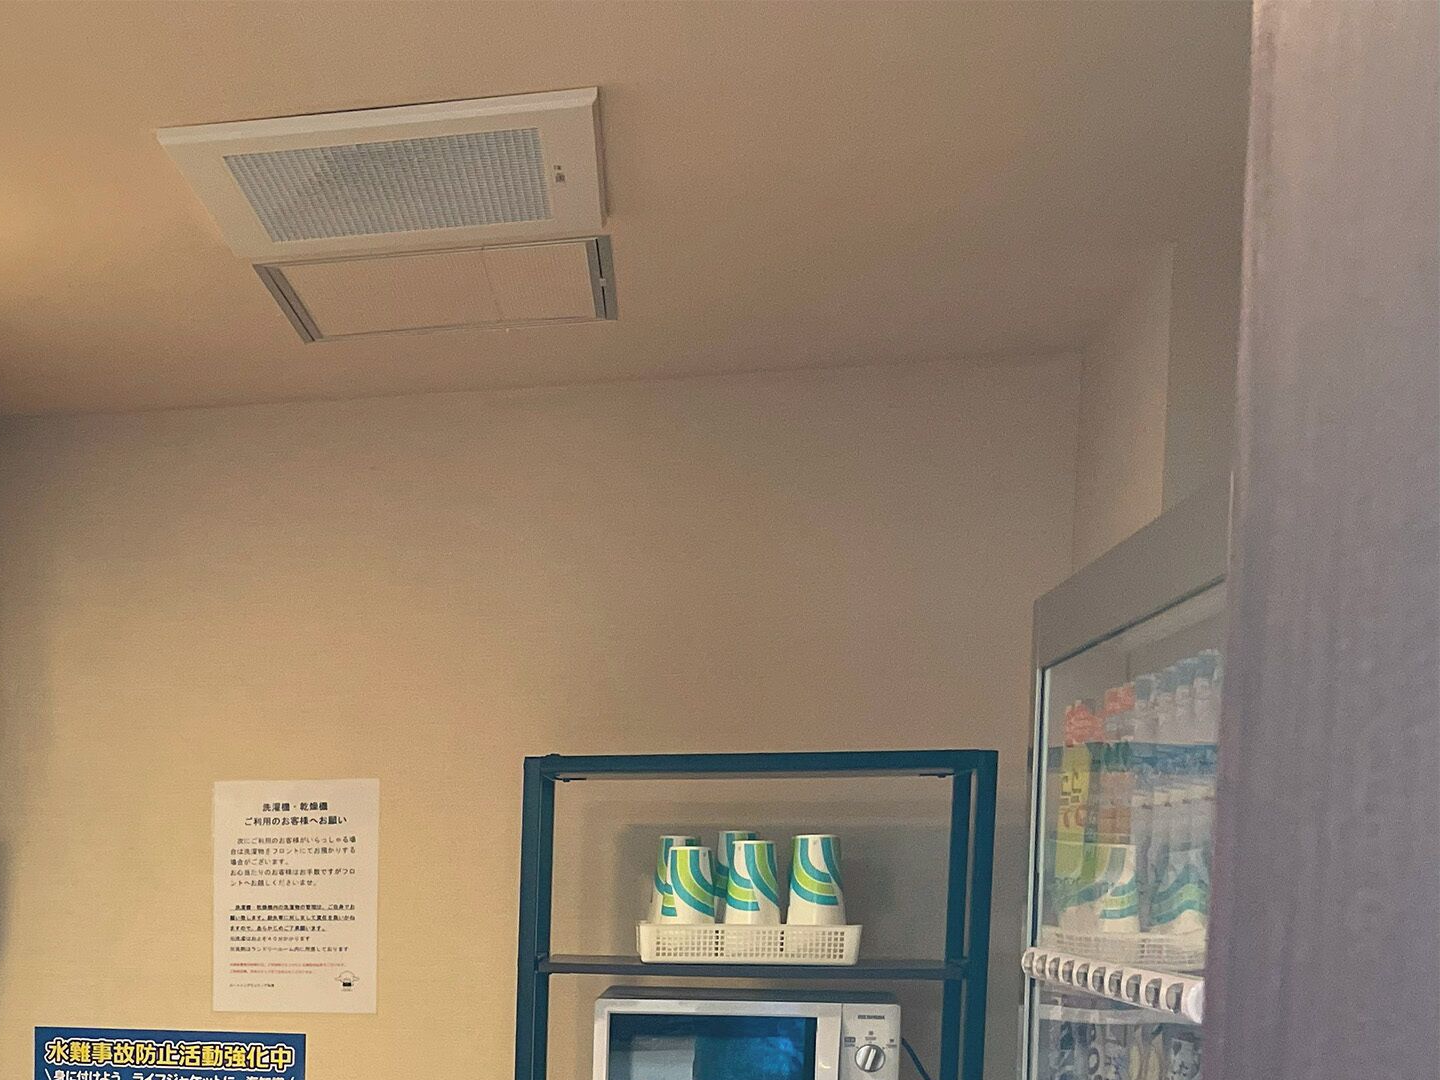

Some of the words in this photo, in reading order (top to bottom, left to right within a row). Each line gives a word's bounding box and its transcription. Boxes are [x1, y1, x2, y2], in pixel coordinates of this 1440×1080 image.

[45, 1038, 294, 1071] 水難事故防止活動強化中
